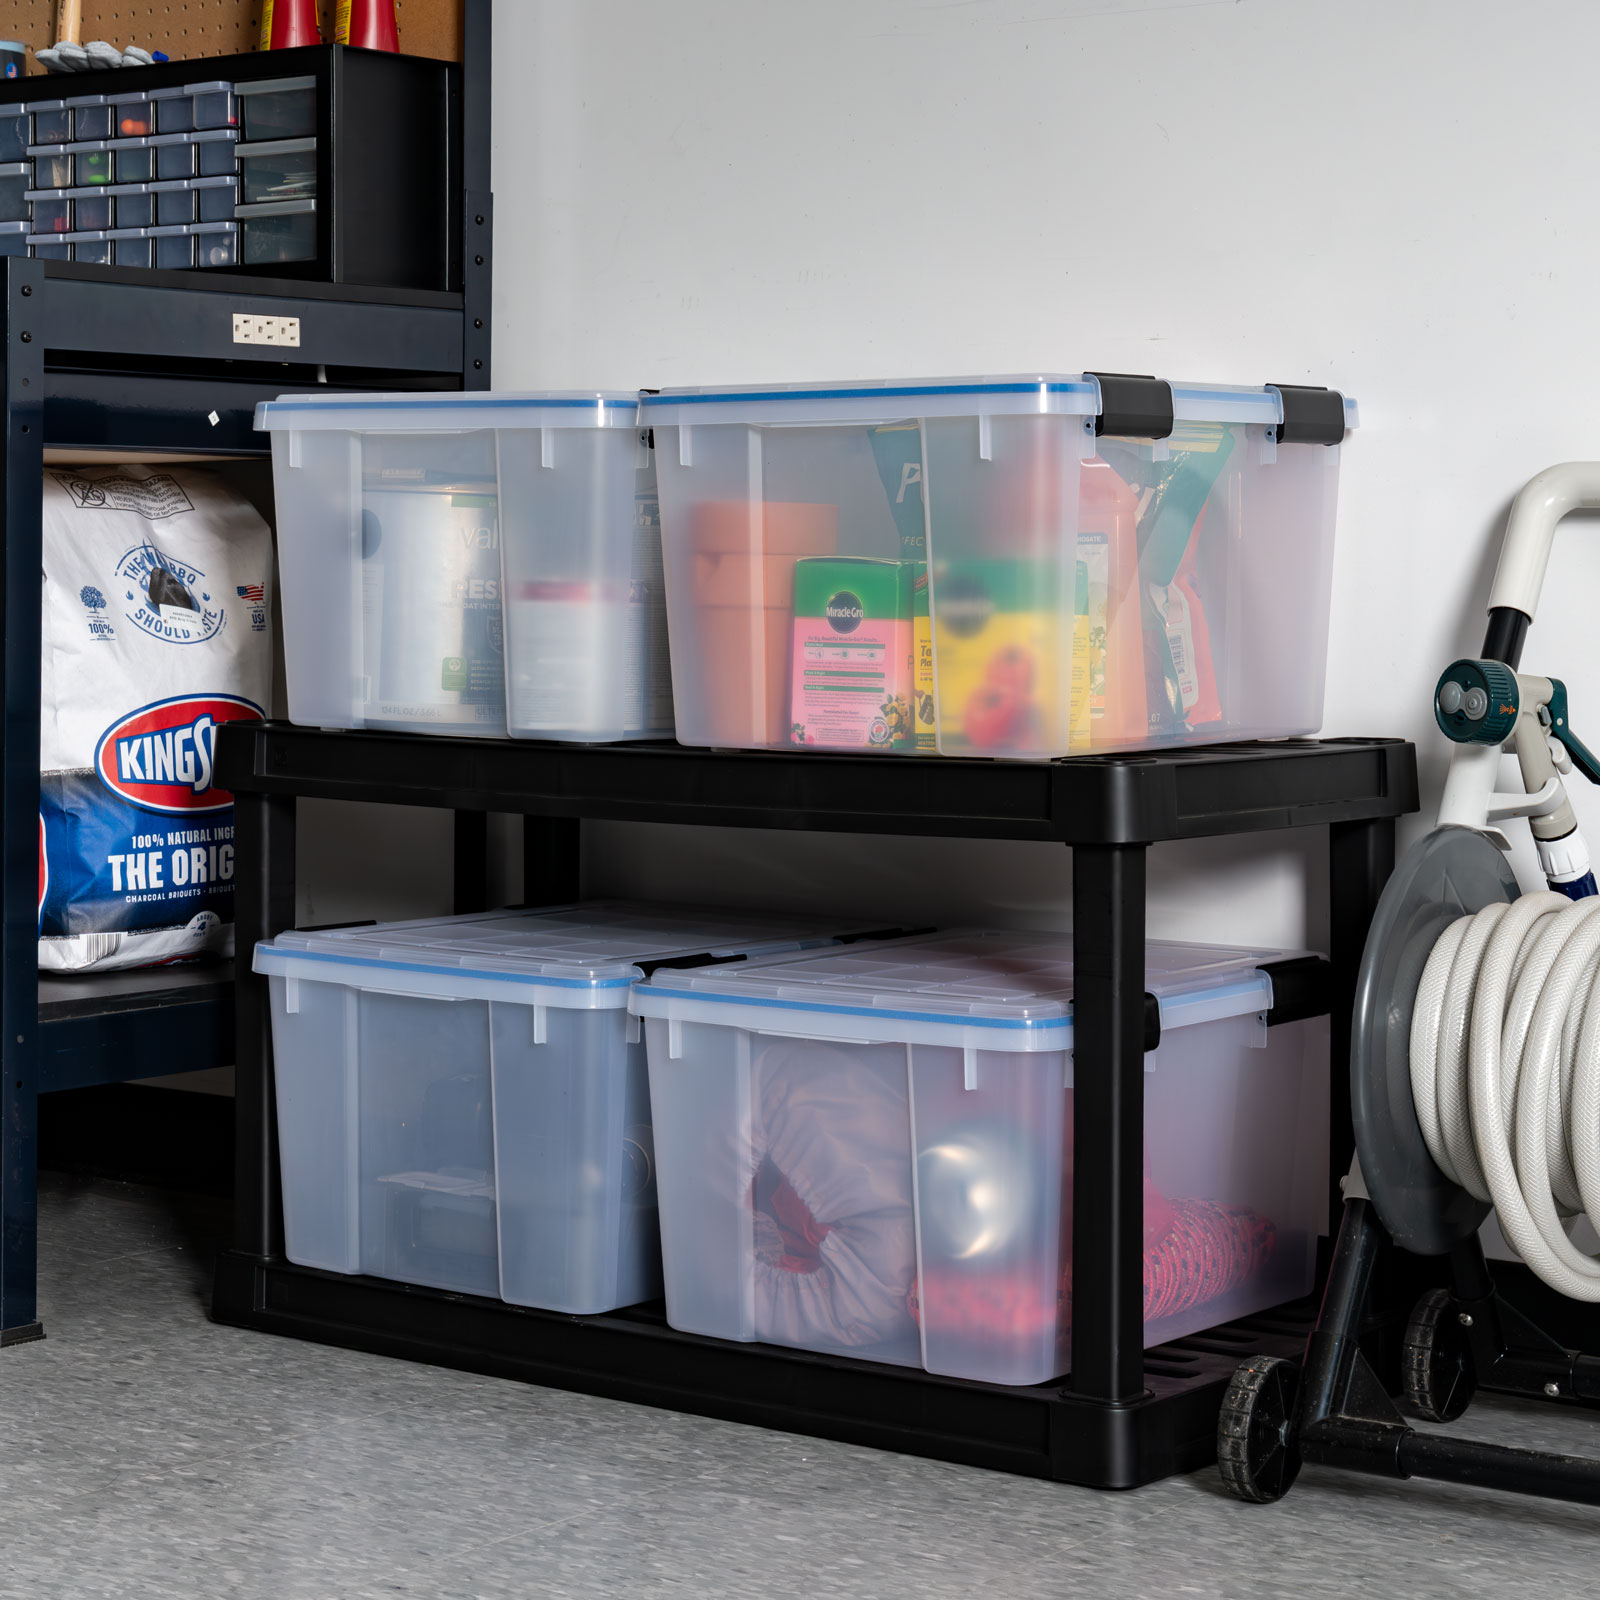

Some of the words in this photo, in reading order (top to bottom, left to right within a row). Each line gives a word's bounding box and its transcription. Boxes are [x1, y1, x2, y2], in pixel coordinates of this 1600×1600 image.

[123, 557, 145, 581] THE
[450, 579, 500, 600] RES
[88, 623, 114, 634] 100%
[134, 608, 191, 639] SHOULD
[252, 613, 265, 624] USA
[119, 717, 216, 791] KINGS
[132, 834, 164, 849] 100%
[167, 829, 211, 846] NATURAL
[108, 851, 164, 892] THE
[172, 844, 234, 886] ORIG
[126, 893, 166, 903] CHARCOAL
[169, 888, 201, 899] BRIQUETS
[198, 921, 206, 931] 4
